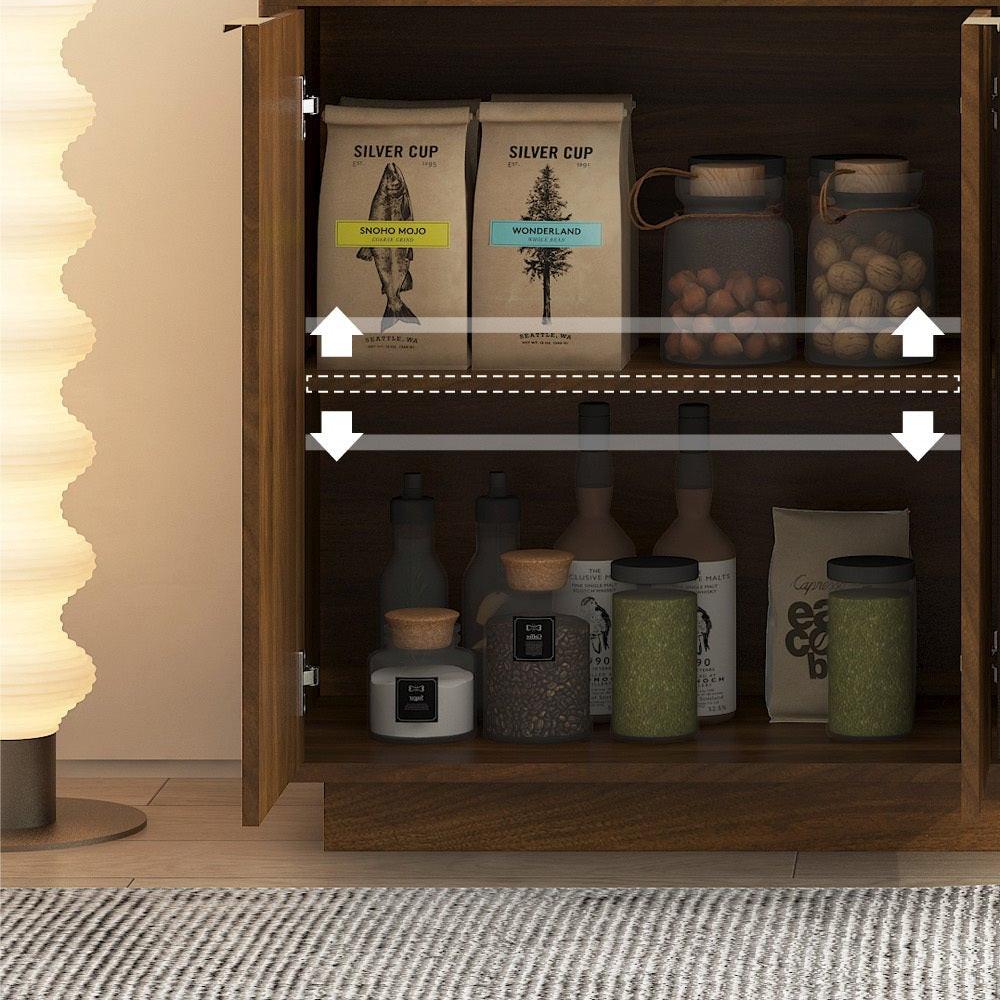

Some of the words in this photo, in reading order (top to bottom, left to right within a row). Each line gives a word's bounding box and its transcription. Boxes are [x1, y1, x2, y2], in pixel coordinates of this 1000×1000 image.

[354, 145, 403, 158] SILVER
[409, 145, 439, 158] CUP
[509, 146, 558, 159] SILVER
[564, 146, 594, 160] CUP
[360, 226, 396, 235] SNOHO
[398, 227, 426, 236] MOJO
[512, 226, 582, 236] WONDERLAND
